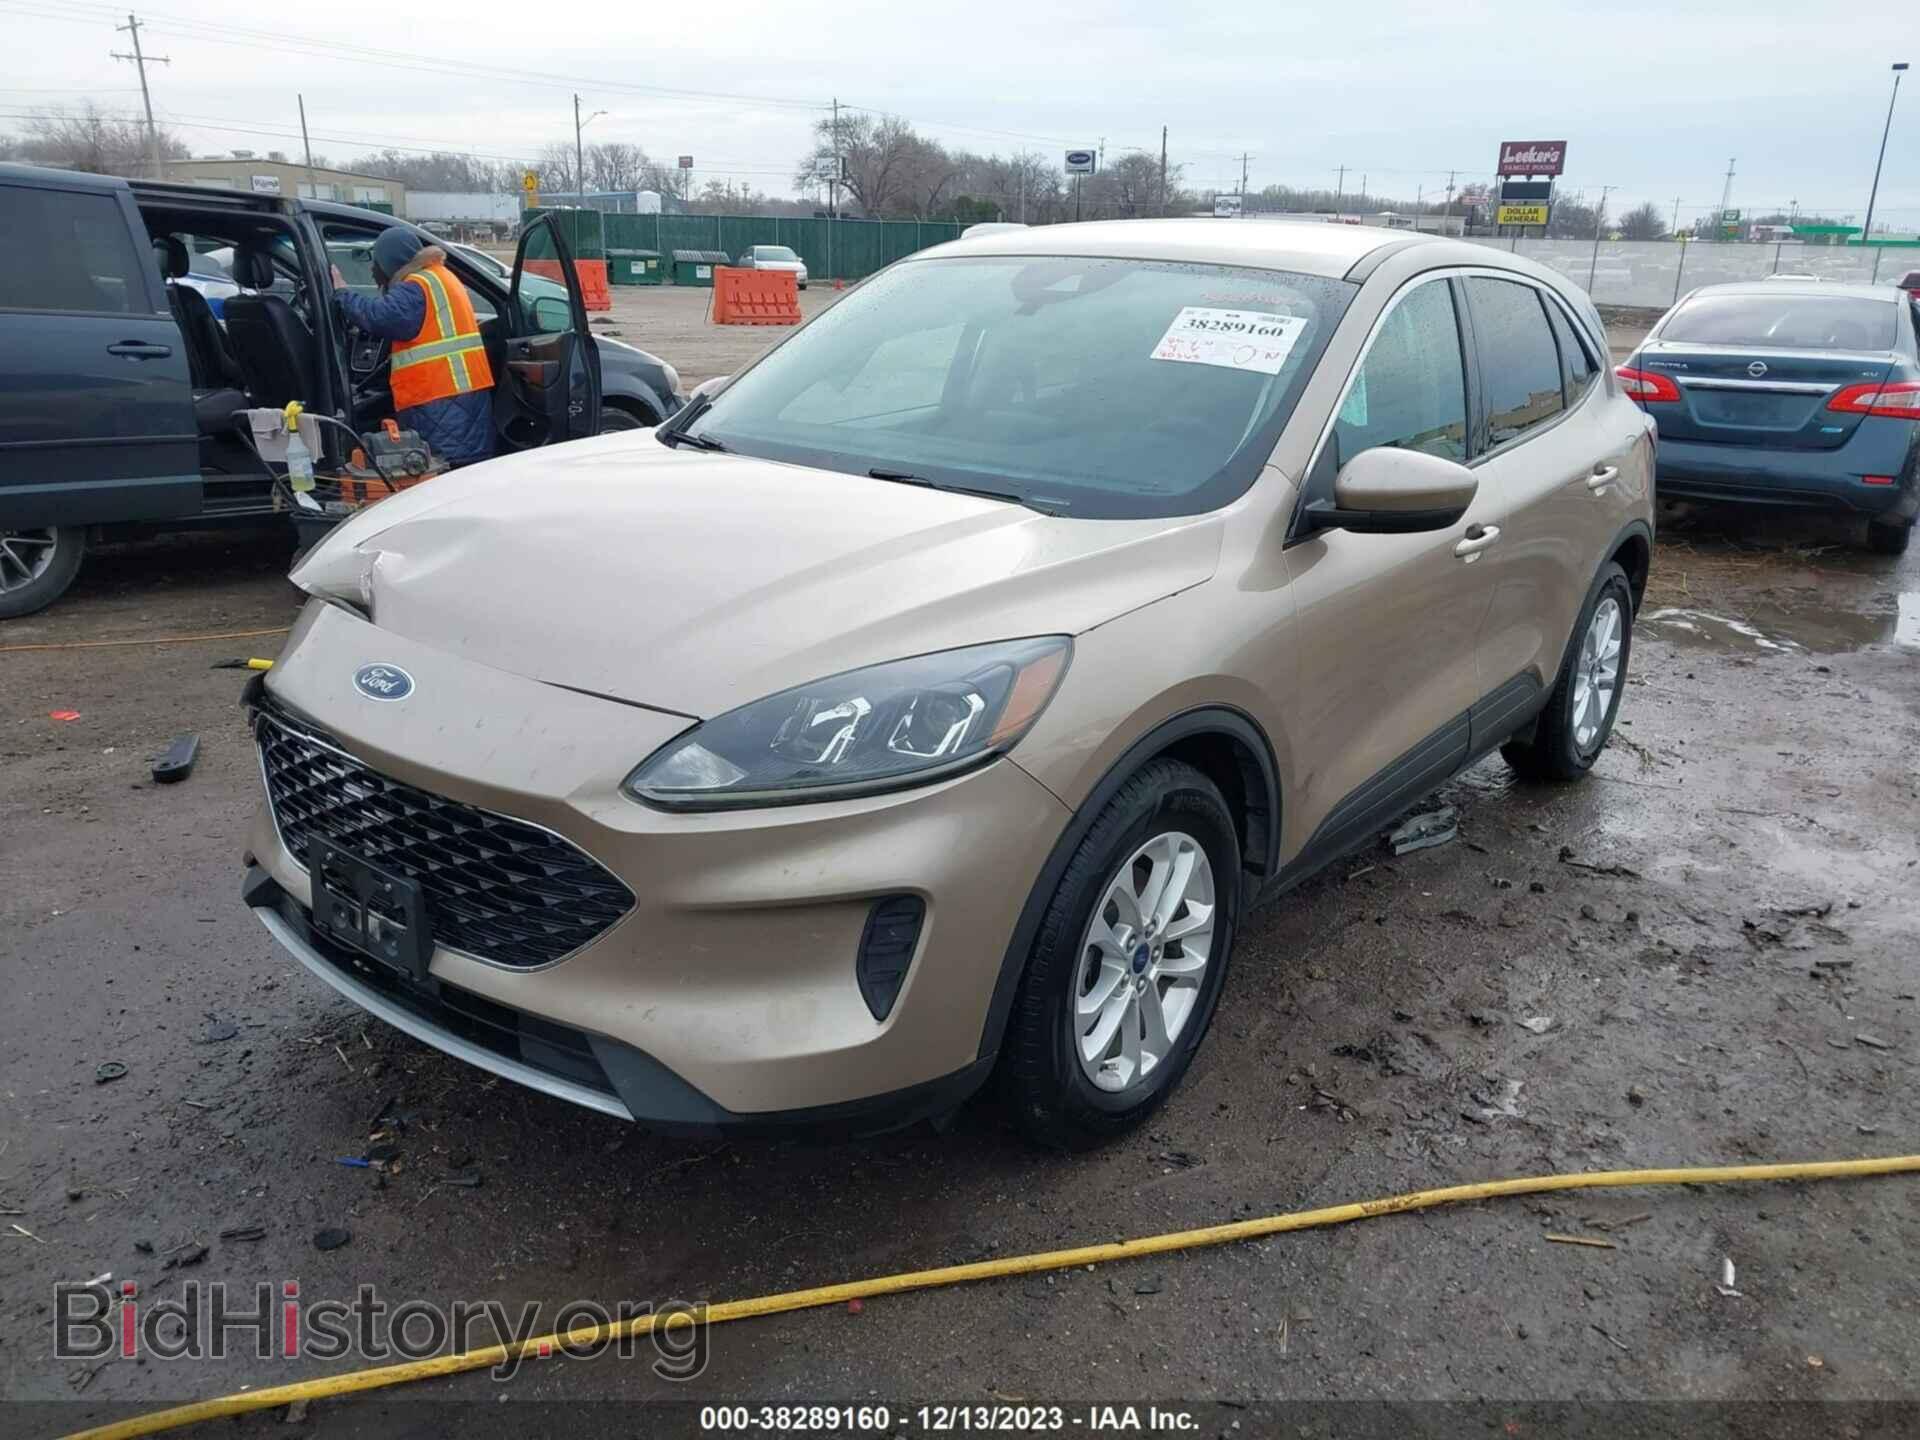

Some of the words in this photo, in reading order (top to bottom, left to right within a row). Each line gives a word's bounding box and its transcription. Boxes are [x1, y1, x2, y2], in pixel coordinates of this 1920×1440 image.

[1503, 145, 1560, 163] Leeker's
[1506, 207, 1540, 215] DOLLAR
[1182, 318, 1284, 337] 38289160
[360, 667, 400, 693] Ford
